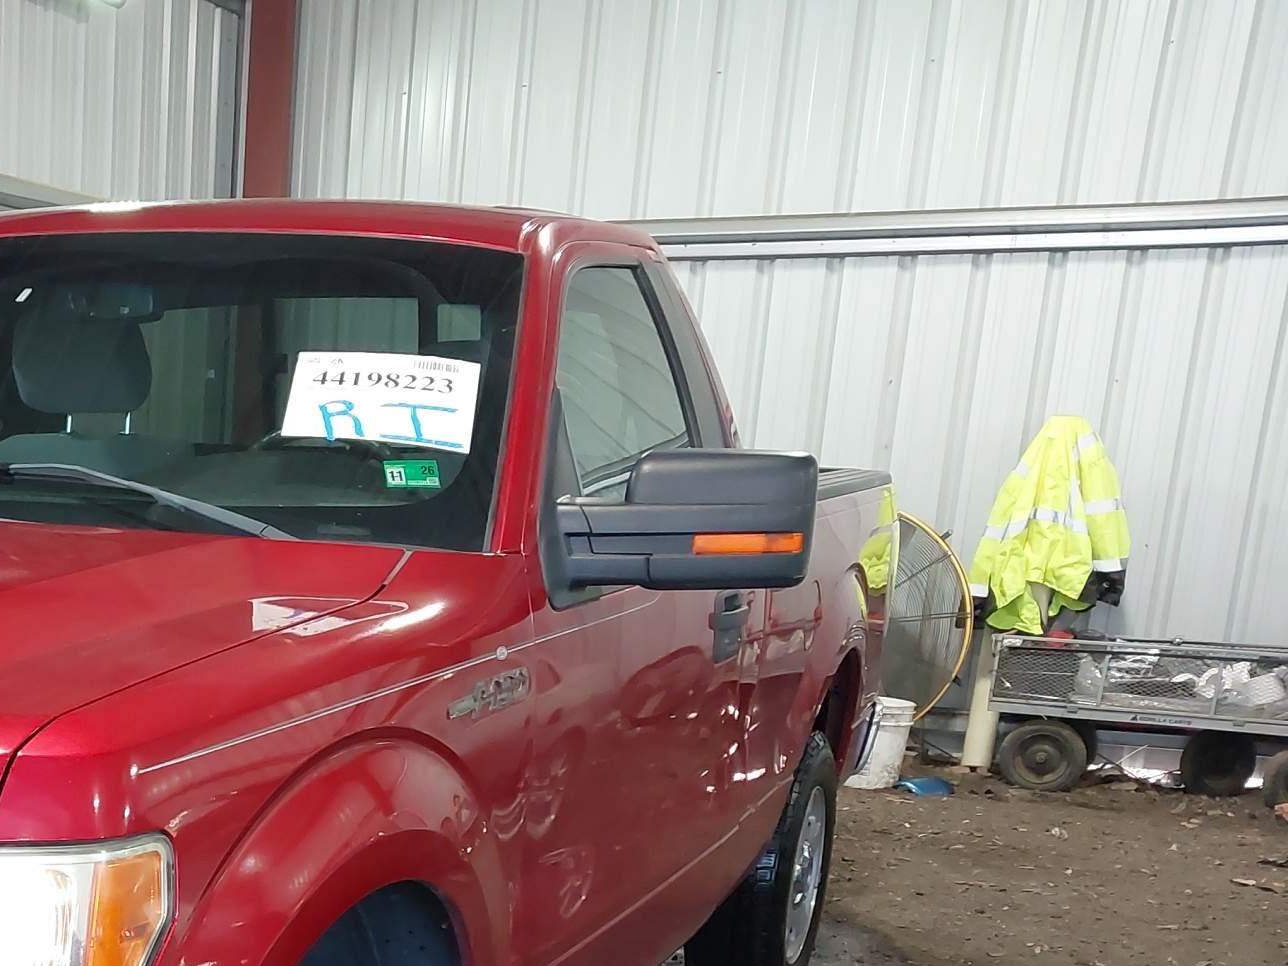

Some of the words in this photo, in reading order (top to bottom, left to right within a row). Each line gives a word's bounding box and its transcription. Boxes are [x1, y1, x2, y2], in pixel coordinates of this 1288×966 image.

[312, 370, 454, 394] 44198223
[388, 470, 404, 482] 11
[420, 465, 435, 475] 26
